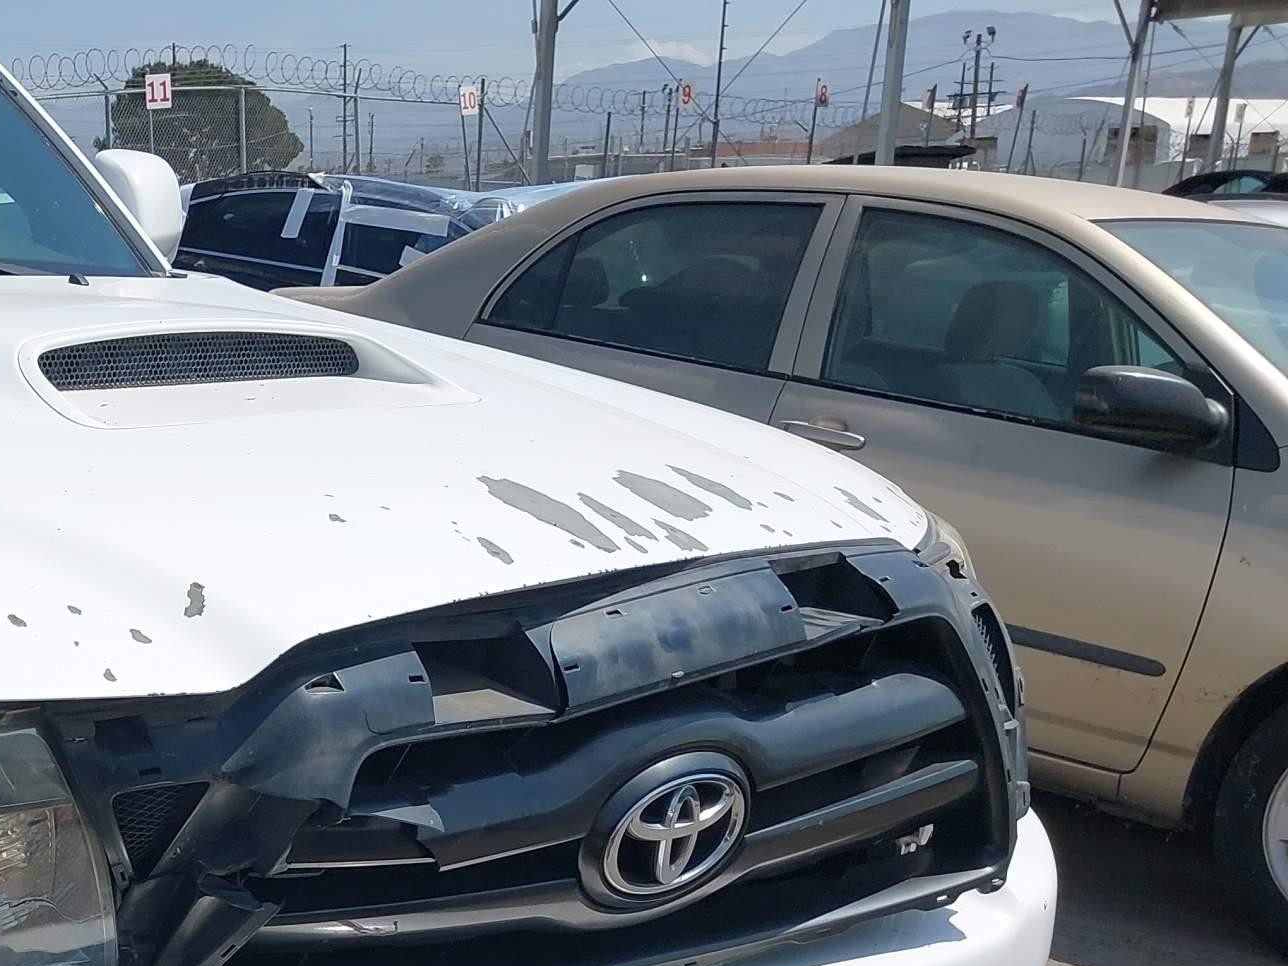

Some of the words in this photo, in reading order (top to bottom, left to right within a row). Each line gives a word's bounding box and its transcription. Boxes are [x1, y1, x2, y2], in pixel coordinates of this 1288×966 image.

[147, 80, 170, 103] 11
[461, 91, 477, 110] 10
[682, 84, 691, 104] 9
[819, 84, 828, 105] 8
